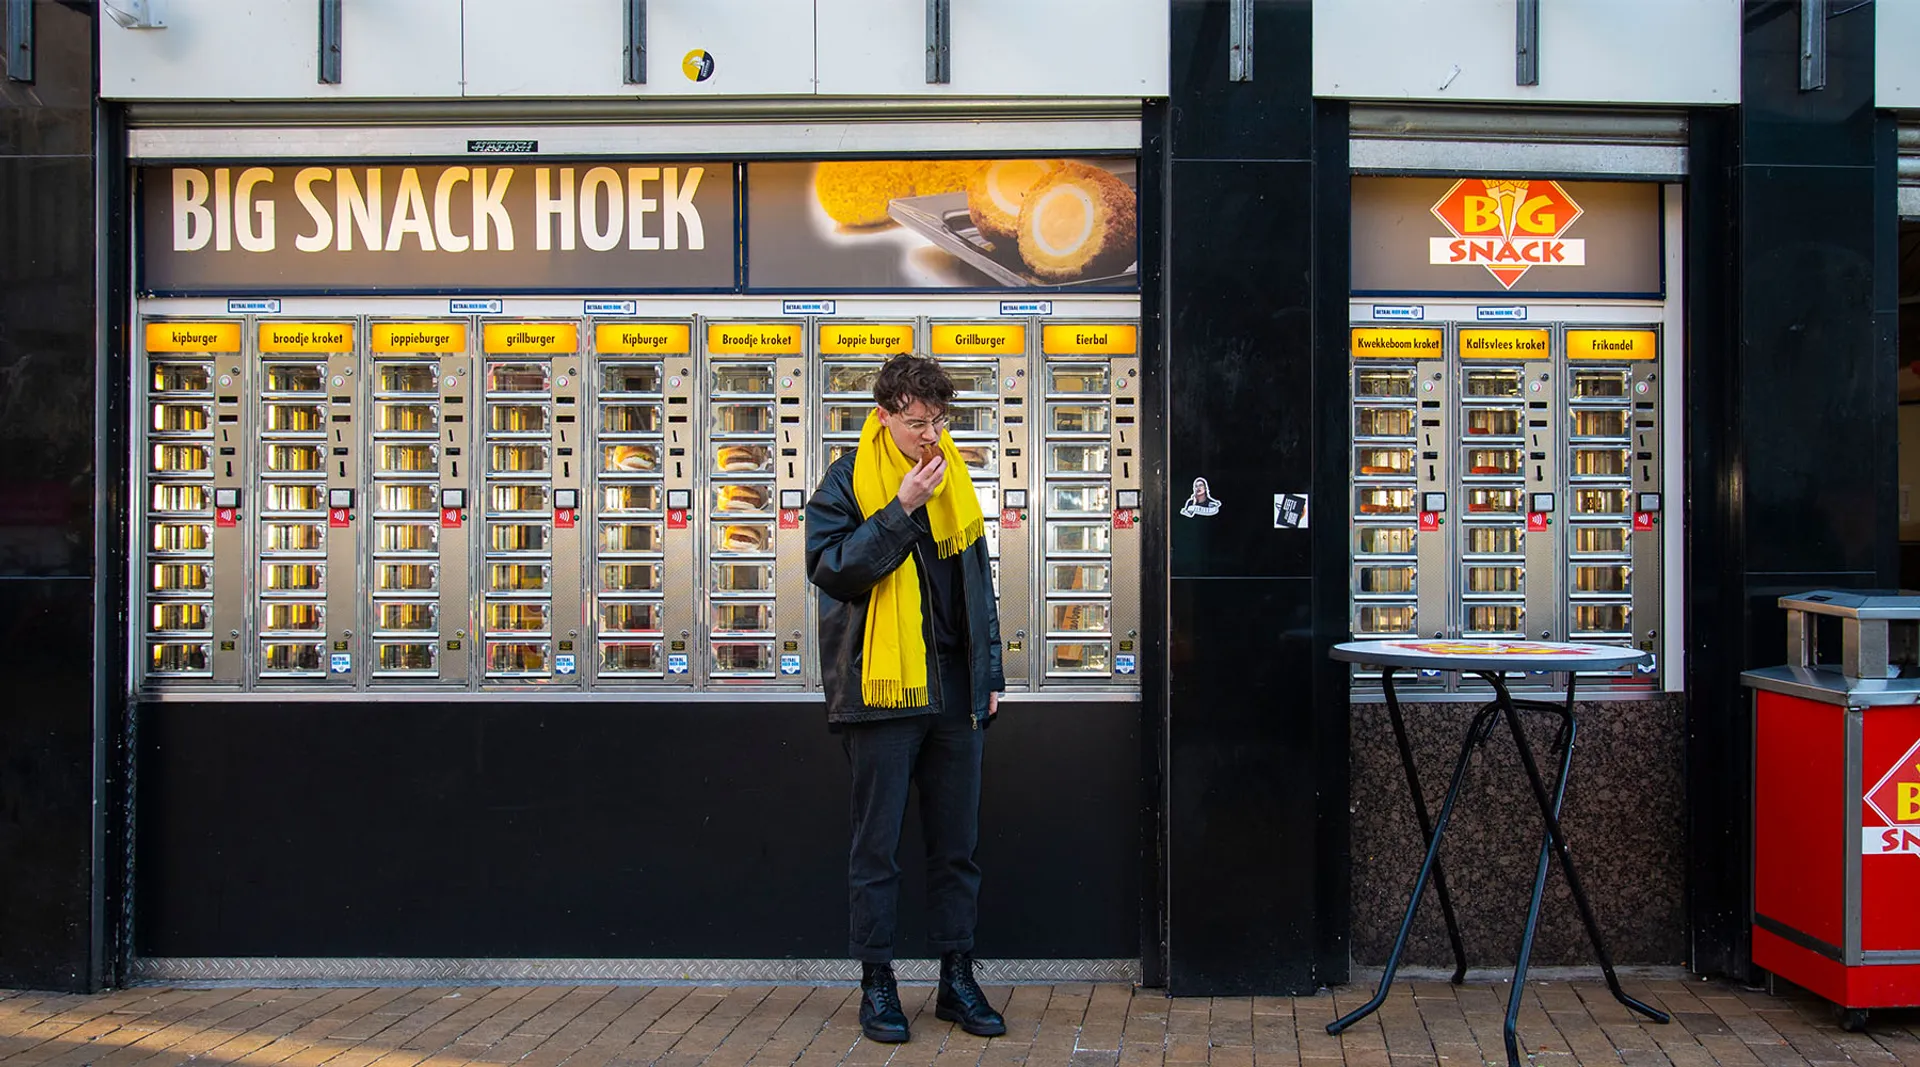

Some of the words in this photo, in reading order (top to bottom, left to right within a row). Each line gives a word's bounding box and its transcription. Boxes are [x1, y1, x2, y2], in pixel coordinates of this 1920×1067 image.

[172, 167, 276, 252] BIG
[294, 167, 515, 252] SNACK
[535, 167, 705, 252] HOEK
[1463, 194, 1556, 234] BIG
[1449, 239, 1565, 263] SNACK
[172, 331, 217, 346] kipburger
[273, 332, 309, 347] broodje
[312, 332, 343, 344] kroket
[391, 332, 450, 347] joppieburger
[506, 332, 555, 347] grillburger
[622, 333, 667, 348] Kipburger
[722, 333, 758, 348] Broodje
[760, 333, 792, 345] kroket
[837, 333, 867, 348] Joppie
[870, 333, 900, 348] burger
[955, 333, 1005, 348] Grillburger
[1076, 333, 1108, 345] Eierbal
[1357, 337, 1412, 349] Kwekkeboom
[1413, 337, 1440, 350] kroket
[1466, 337, 1513, 350] Kalfsvlees
[1515, 338, 1546, 350] kroket
[1592, 339, 1633, 351] Frikandel
[1897, 782, 1920, 821] B
[1881, 828, 1920, 852] SN
